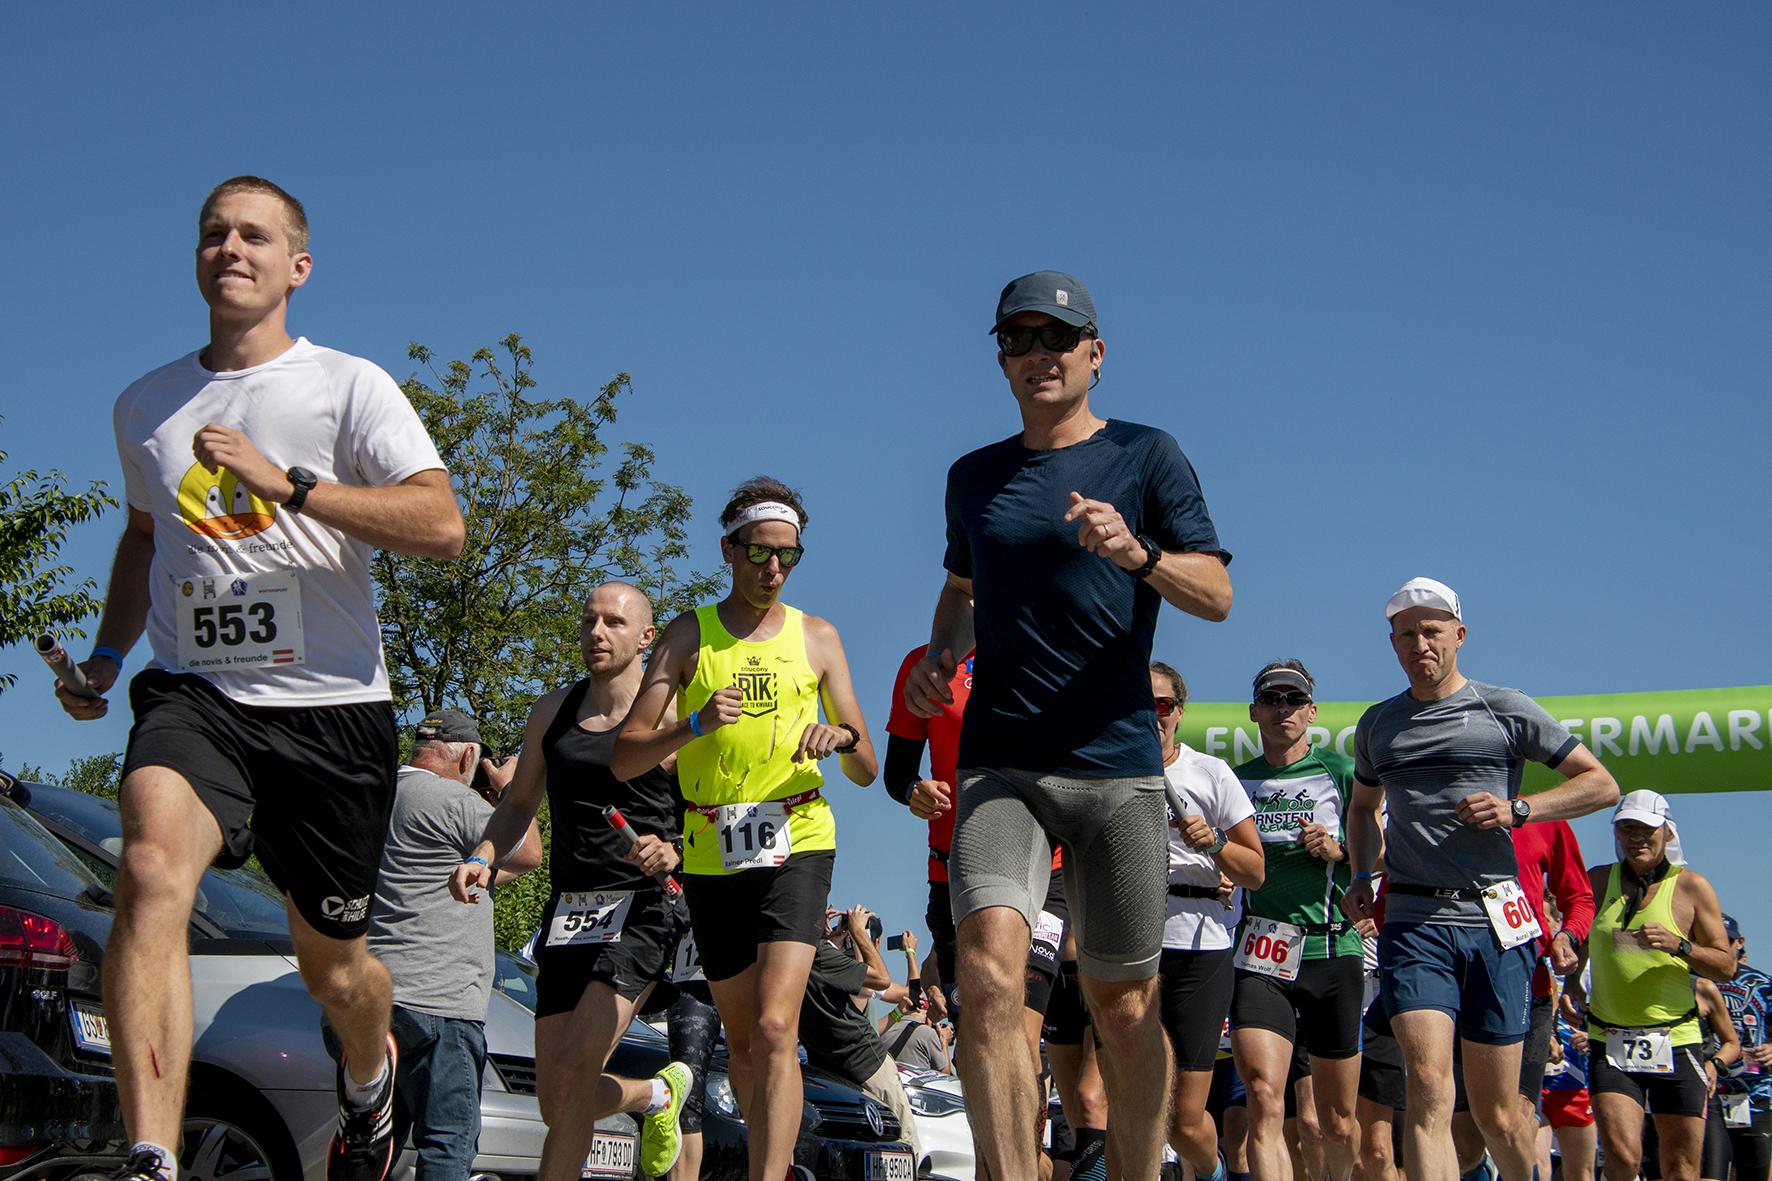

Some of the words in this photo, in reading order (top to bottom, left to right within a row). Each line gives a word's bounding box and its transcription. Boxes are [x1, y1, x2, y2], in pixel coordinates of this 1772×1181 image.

[249, 539, 293, 553] freunde
[193, 602, 277, 648] 553
[225, 656, 231, 664] &
[234, 654, 268, 664] freunde
[738, 673, 772, 701] RTK
[1253, 812, 1314, 824] RNSTEIN
[721, 821, 777, 853] 116
[564, 909, 616, 931] 554
[1244, 933, 1289, 963] 606
[1623, 1039, 1652, 1060] 73
[590, 1139, 601, 1165] HF
